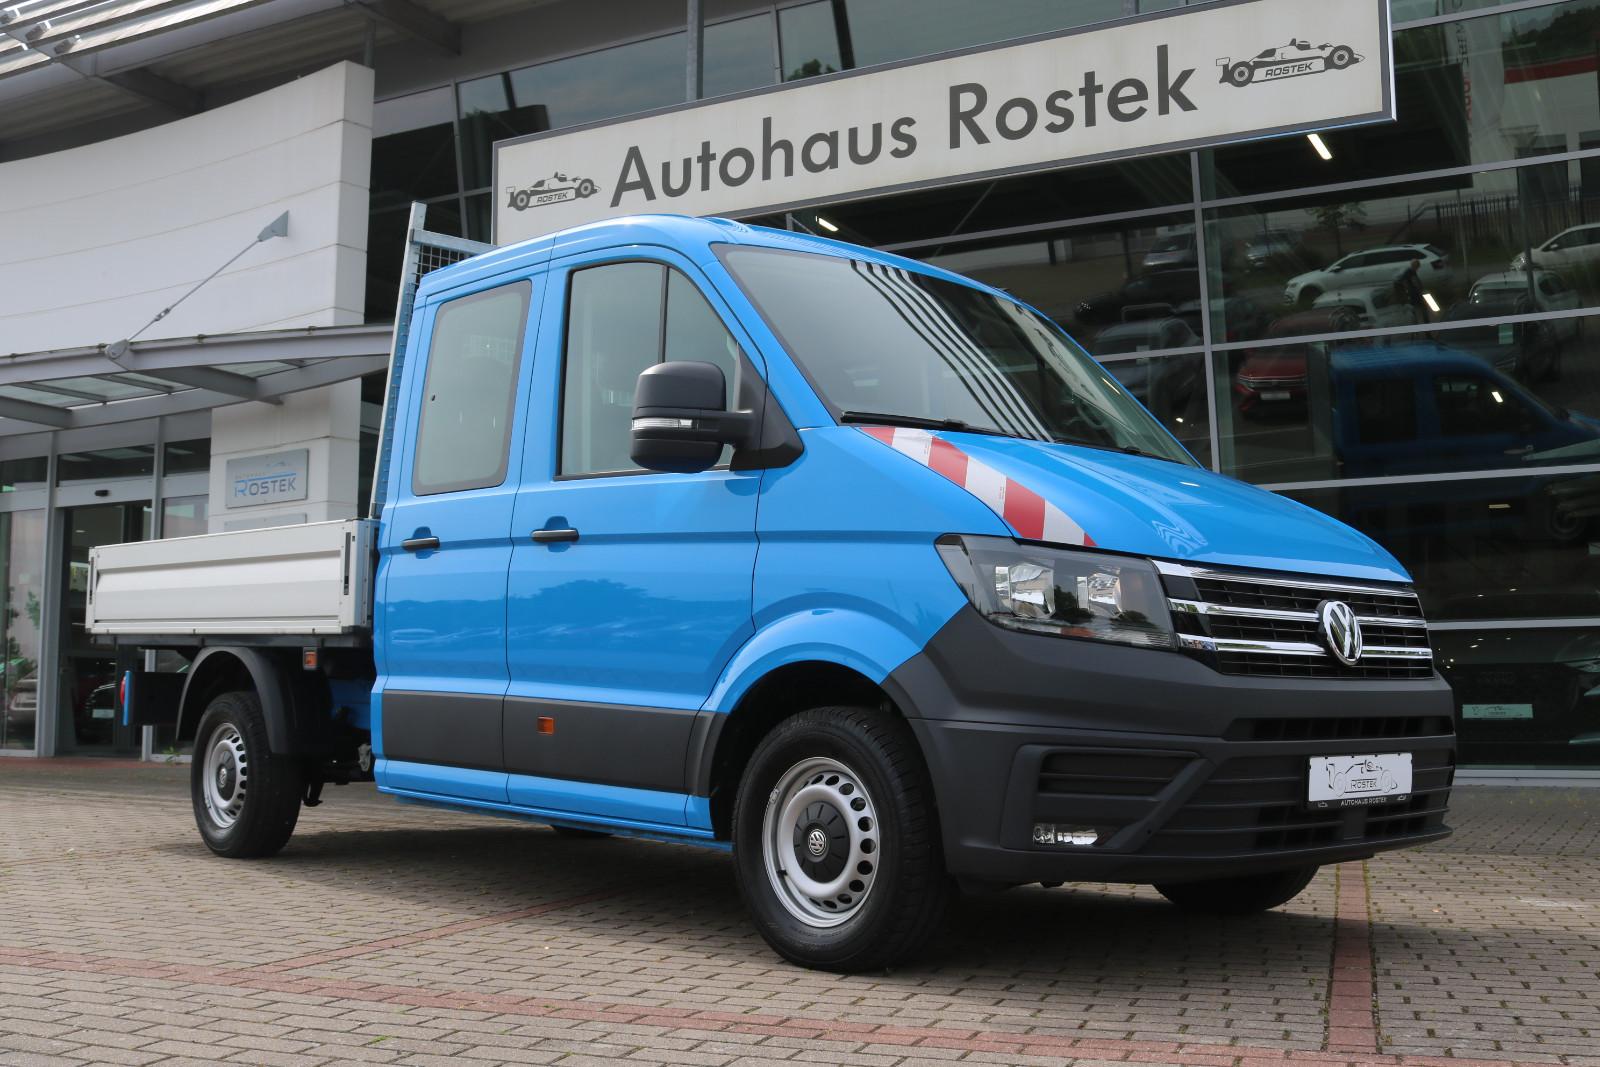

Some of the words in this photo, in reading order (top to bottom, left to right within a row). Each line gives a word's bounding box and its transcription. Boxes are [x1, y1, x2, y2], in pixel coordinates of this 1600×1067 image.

[1265, 61, 1313, 77] ROSTEK
[609, 116, 917, 208] Autohaus
[949, 44, 1198, 150] Rostek
[537, 192, 568, 203] ROSTEK
[235, 477, 296, 496] ROSTEK
[1351, 781, 1377, 789] ROSTEK
[1341, 798, 1368, 806] AUTOHAUS
